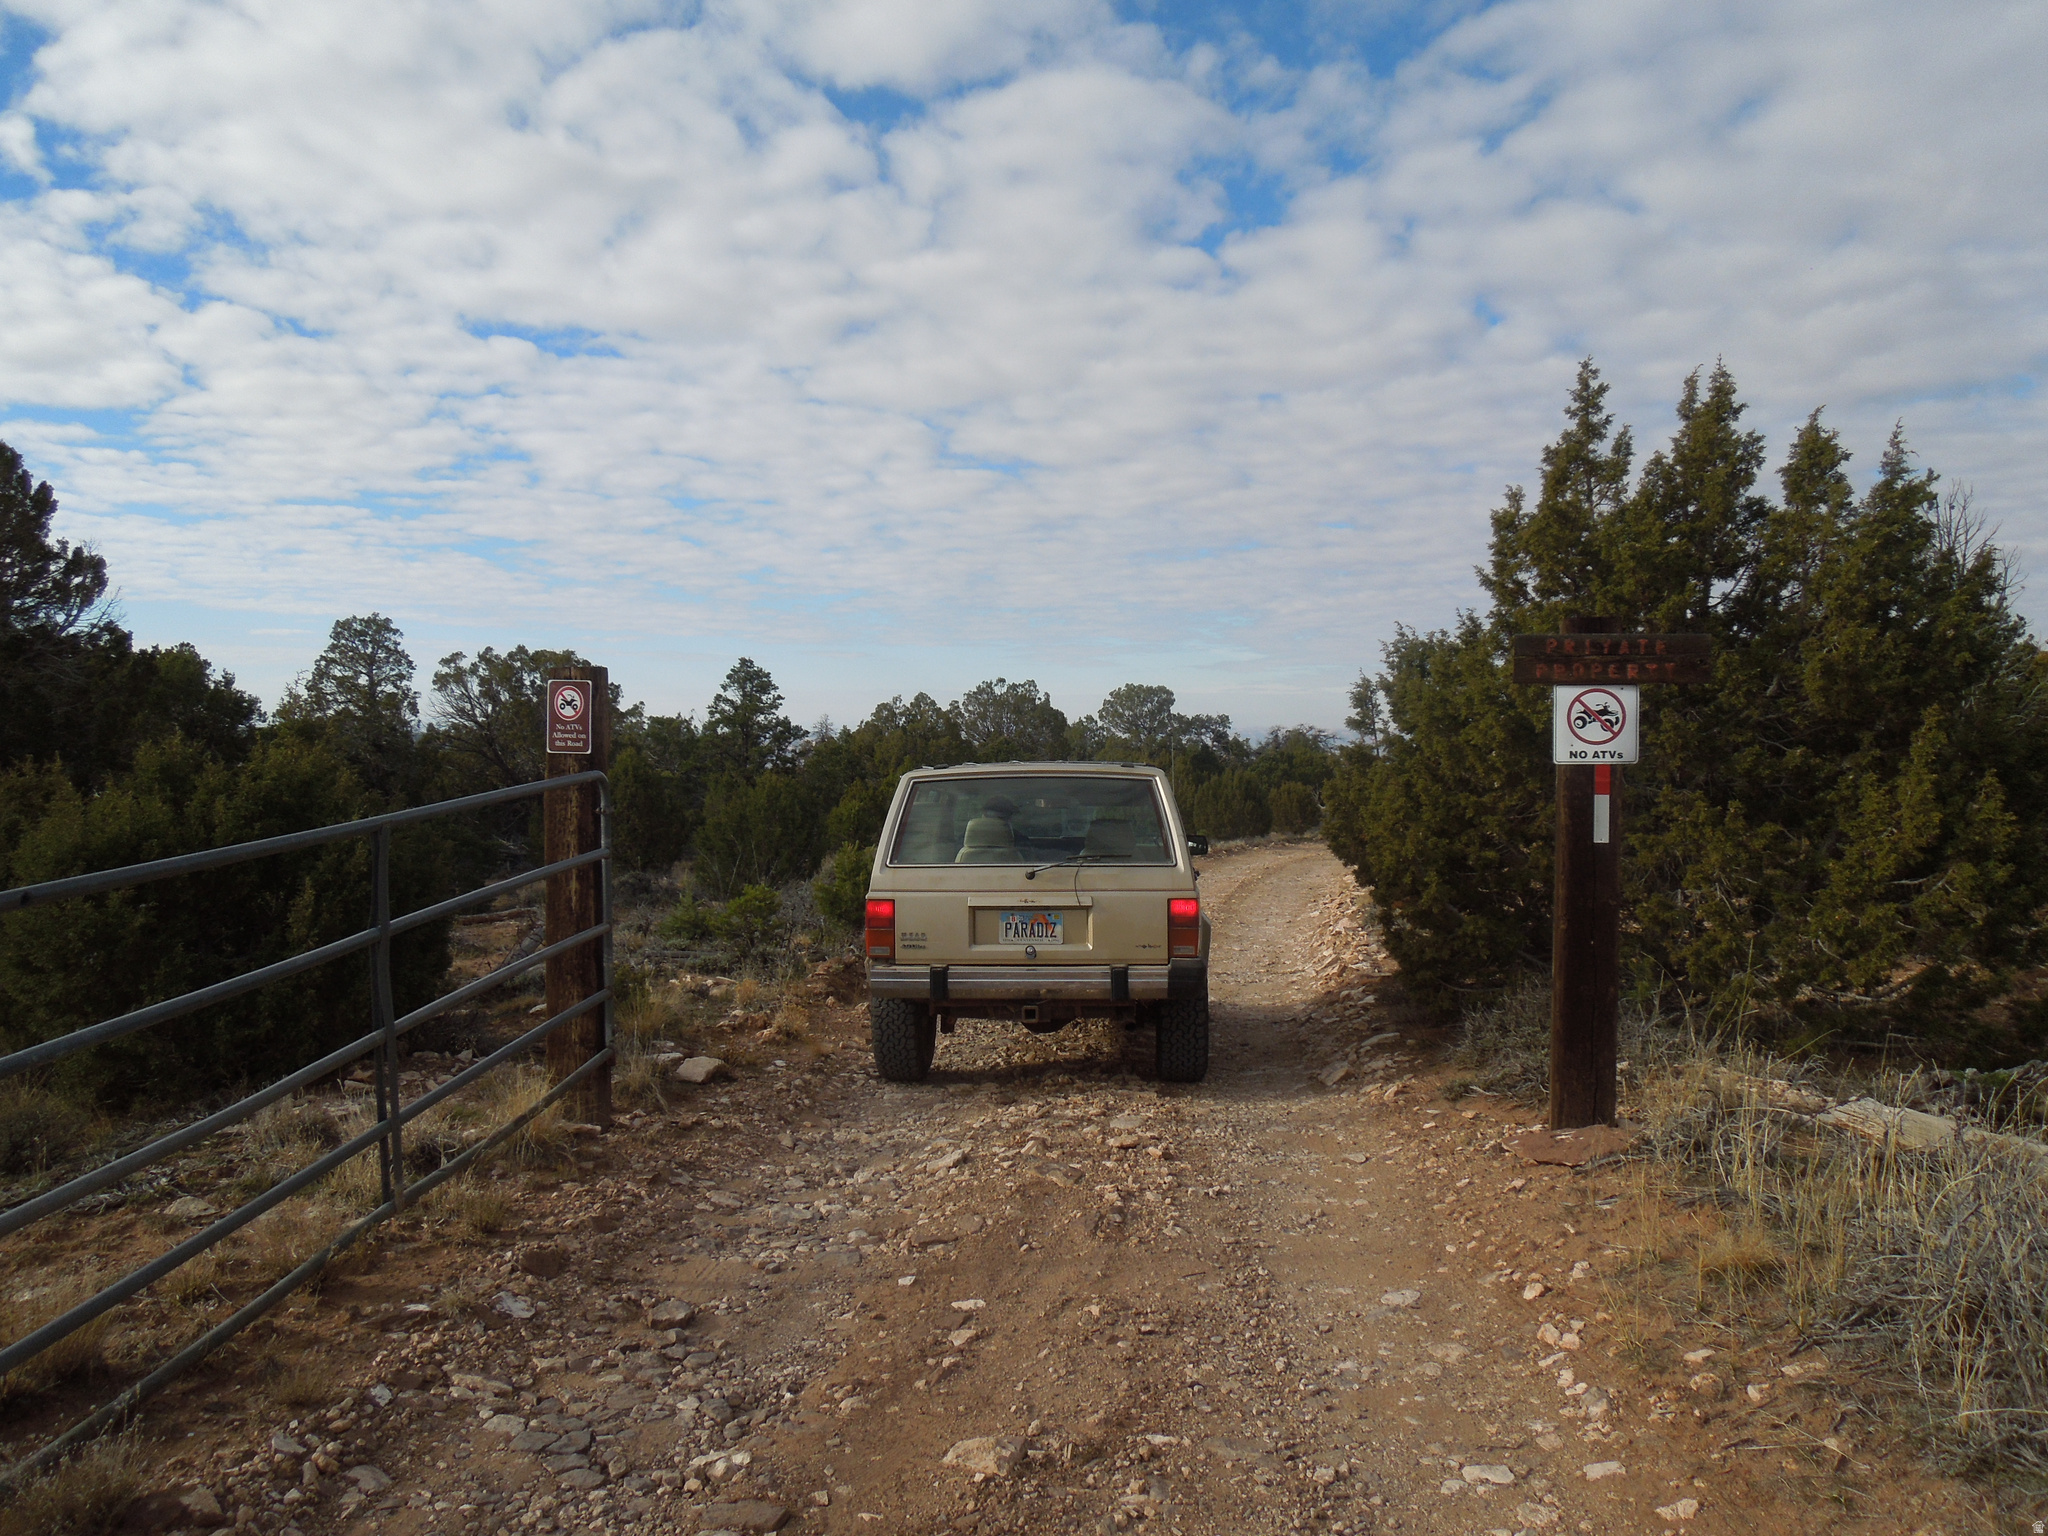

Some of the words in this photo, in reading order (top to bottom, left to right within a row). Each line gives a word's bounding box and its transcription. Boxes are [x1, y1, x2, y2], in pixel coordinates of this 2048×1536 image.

[1536, 662, 1676, 679] PROPERTY
[1569, 750, 1588, 759] NO
[1592, 750, 1624, 759] ATVs
[1004, 922, 1057, 938] PARADIZ
